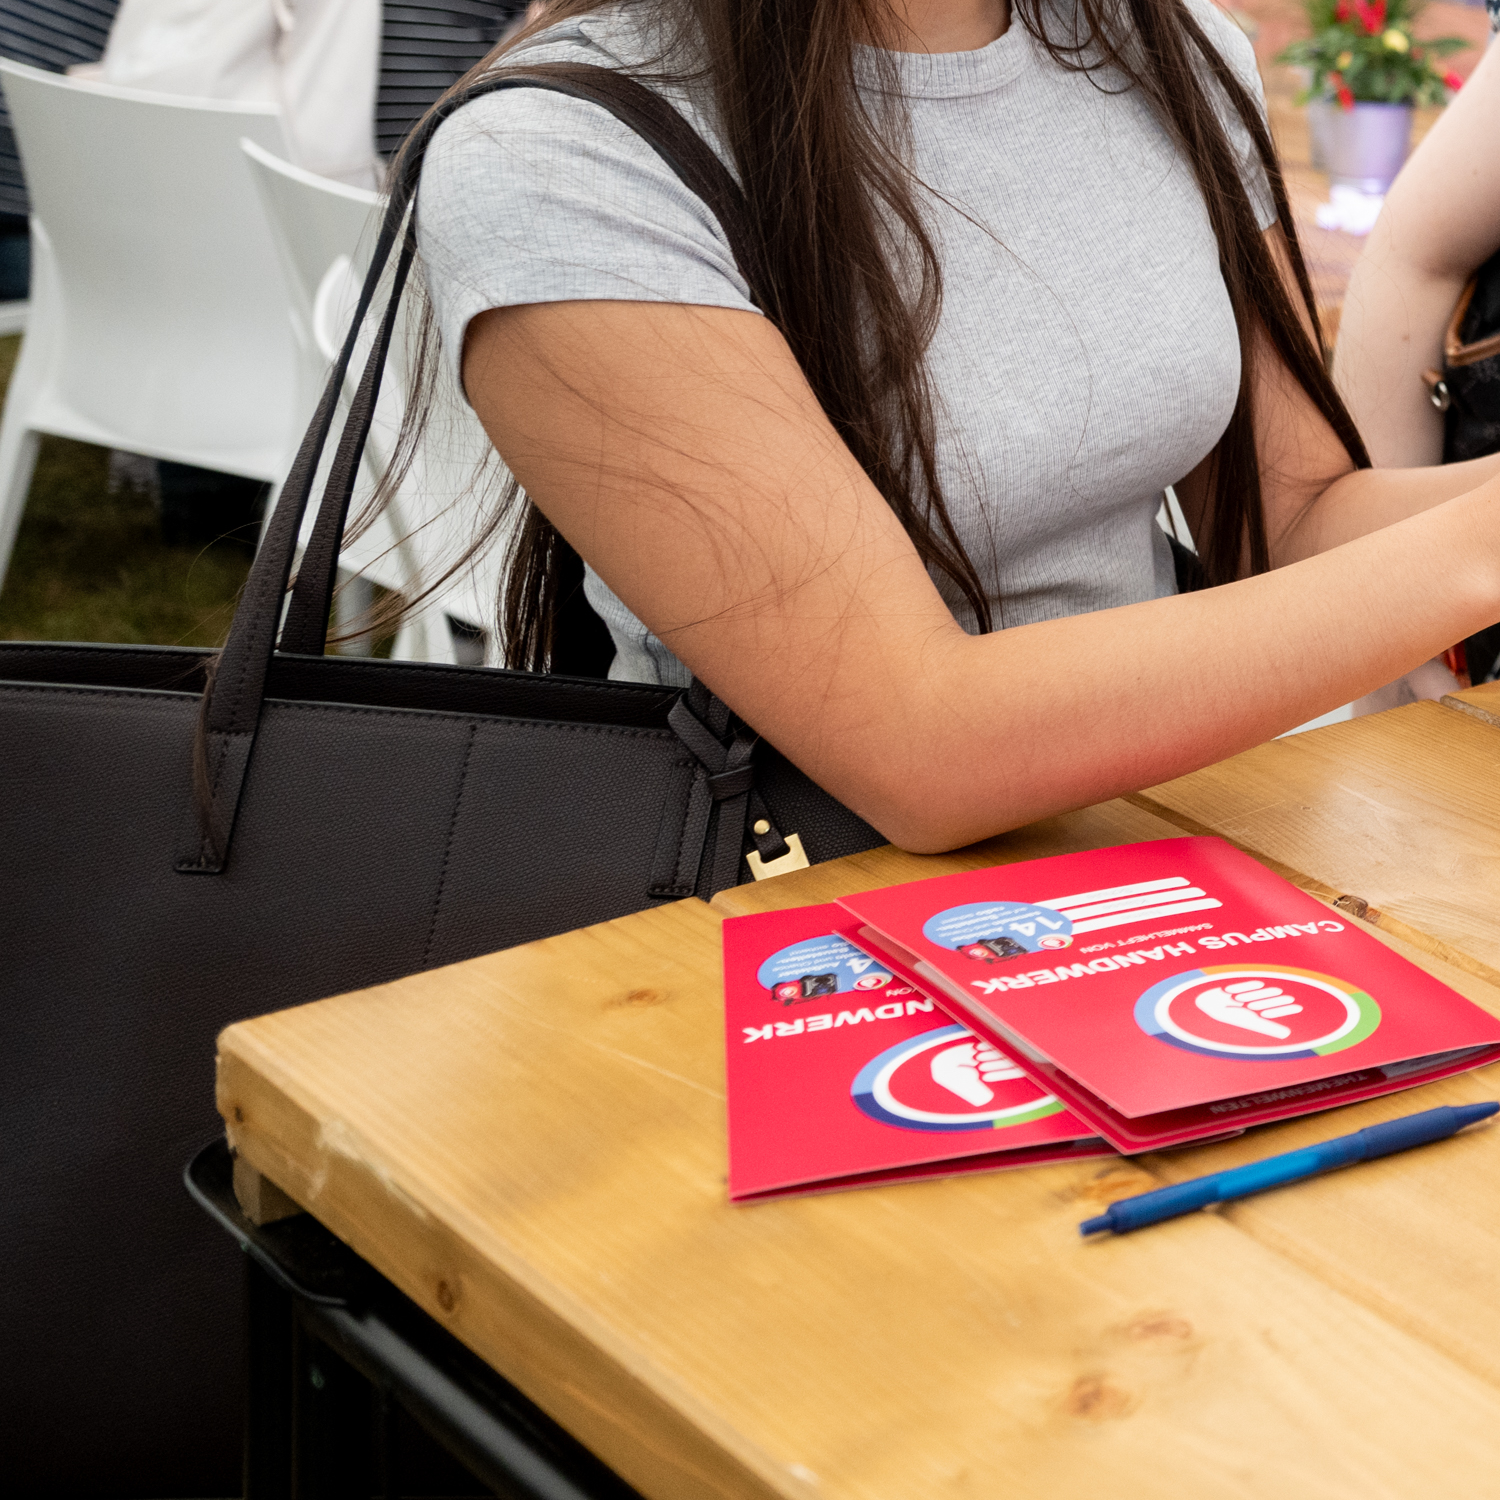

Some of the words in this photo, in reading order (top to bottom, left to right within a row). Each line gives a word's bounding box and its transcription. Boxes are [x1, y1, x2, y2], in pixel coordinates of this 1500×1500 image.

[1009, 916, 1064, 937] 14
[1115, 922, 1214, 948] SAMMELHEFT
[1197, 920, 1346, 951] CAMPUS
[1079, 941, 1116, 954] VON
[971, 941, 1197, 995] HANDWERK
